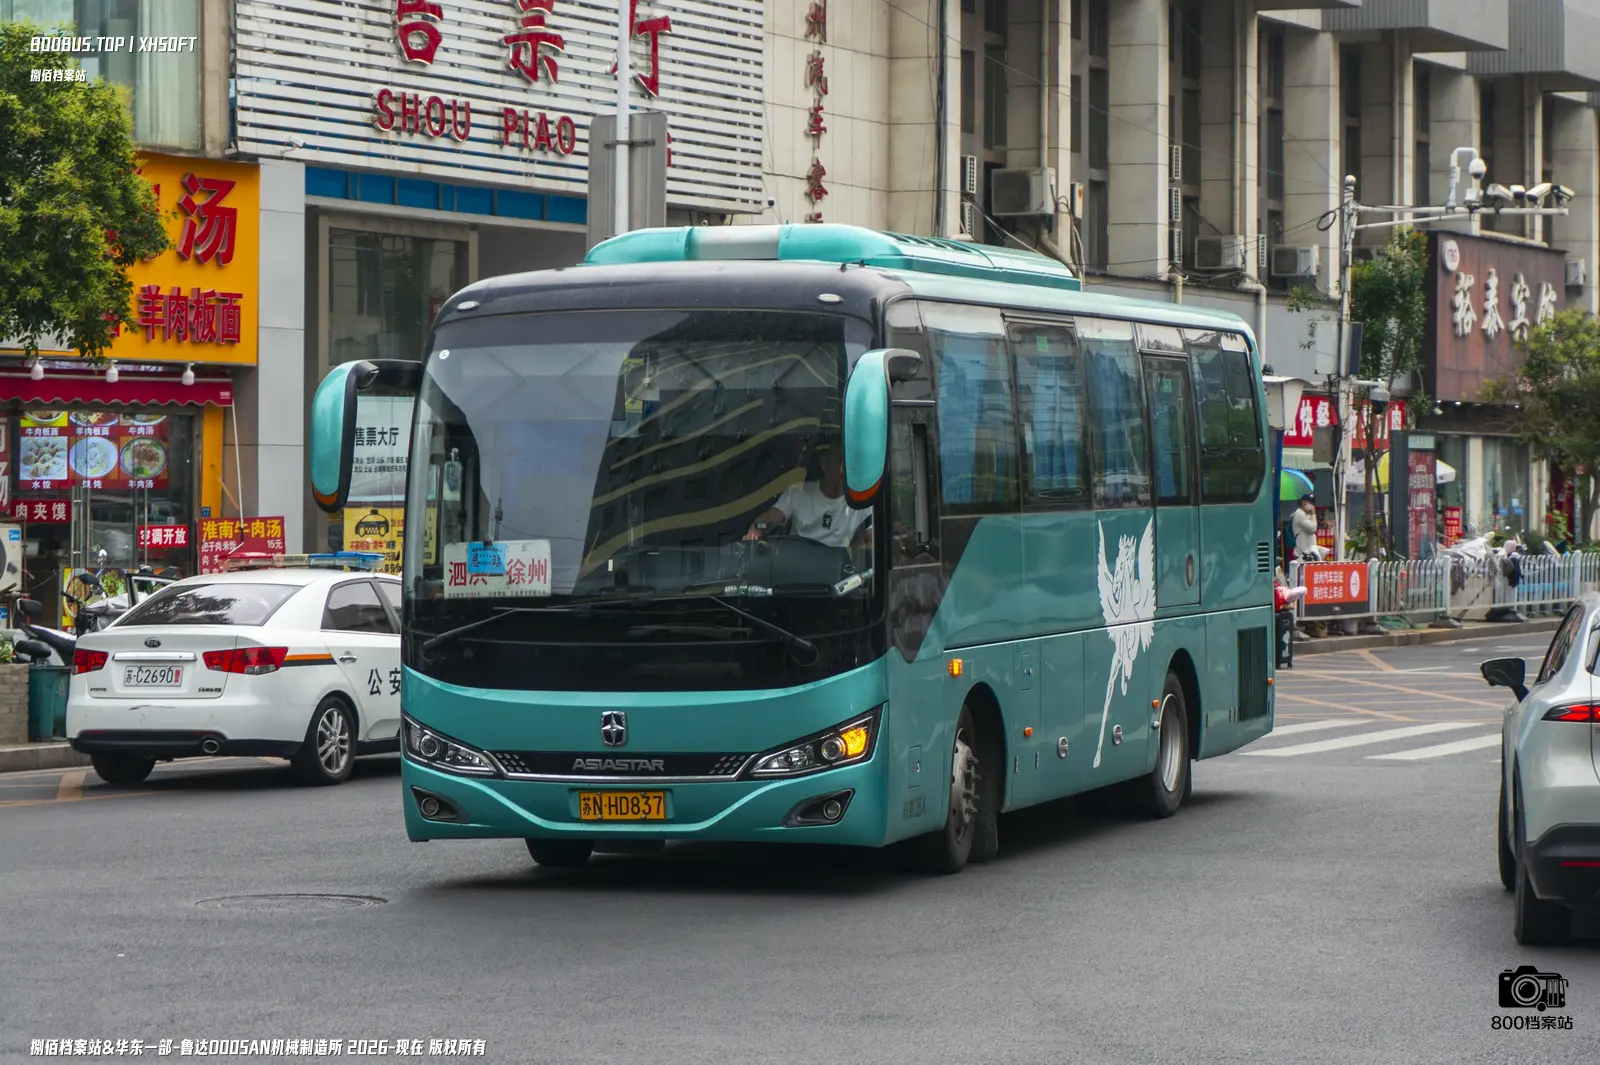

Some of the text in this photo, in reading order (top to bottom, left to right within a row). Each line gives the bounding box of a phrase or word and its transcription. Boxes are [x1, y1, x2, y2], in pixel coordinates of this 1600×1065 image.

[374, 87, 577, 156] SHOU PIAO
[137, 284, 243, 345] 羊肉板面
[25, 427, 59, 436] 牛肉板面
[76, 427, 110, 436] 羊肉板面
[128, 426, 154, 435] 牛肉汤
[355, 426, 399, 447] 售票大厅
[15, 503, 67, 520] 肉夹馍
[140, 528, 187, 545] 空调开放
[202, 519, 281, 540] 淮南牛肉汤
[367, 667, 401, 696] 公安
[572, 758, 665, 771] ASIASTAR
